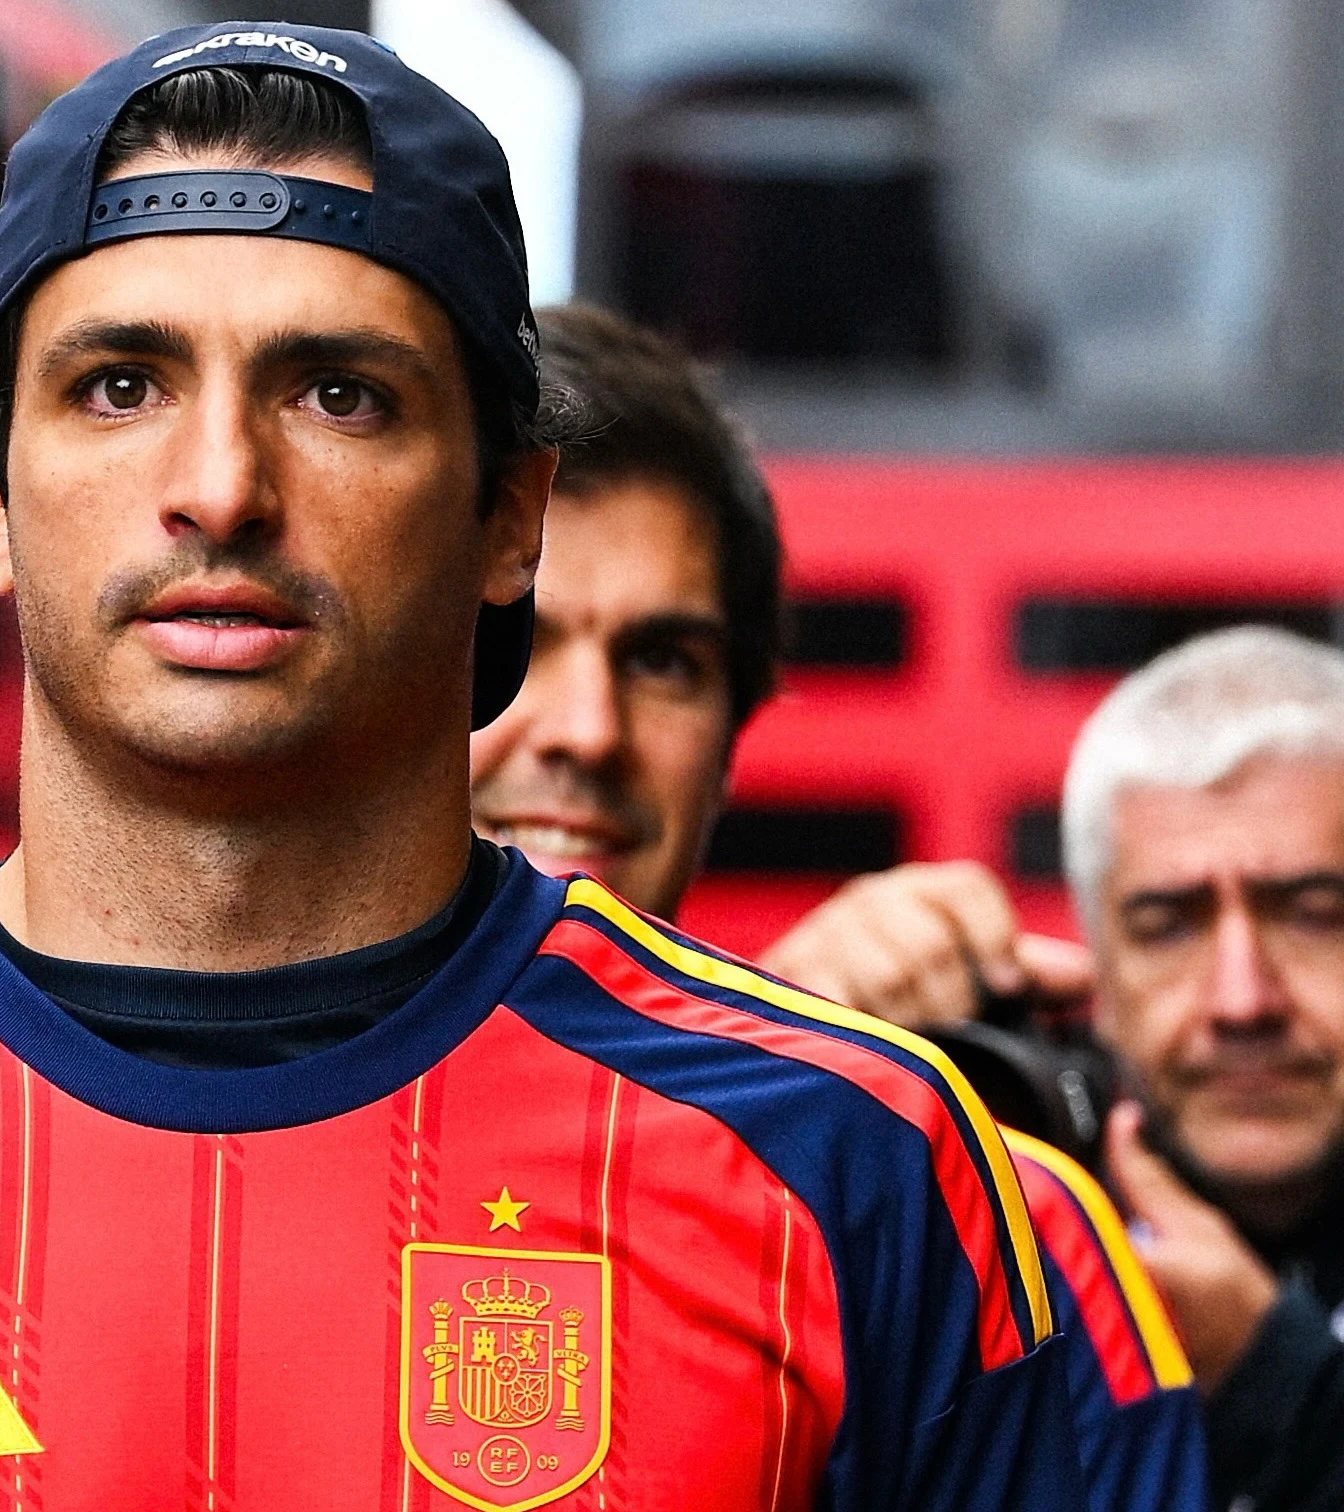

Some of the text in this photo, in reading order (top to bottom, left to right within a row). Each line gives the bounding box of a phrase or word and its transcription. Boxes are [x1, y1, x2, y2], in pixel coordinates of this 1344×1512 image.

[193, 32, 347, 73] kraken
[453, 1451, 559, 1471] 19 09
